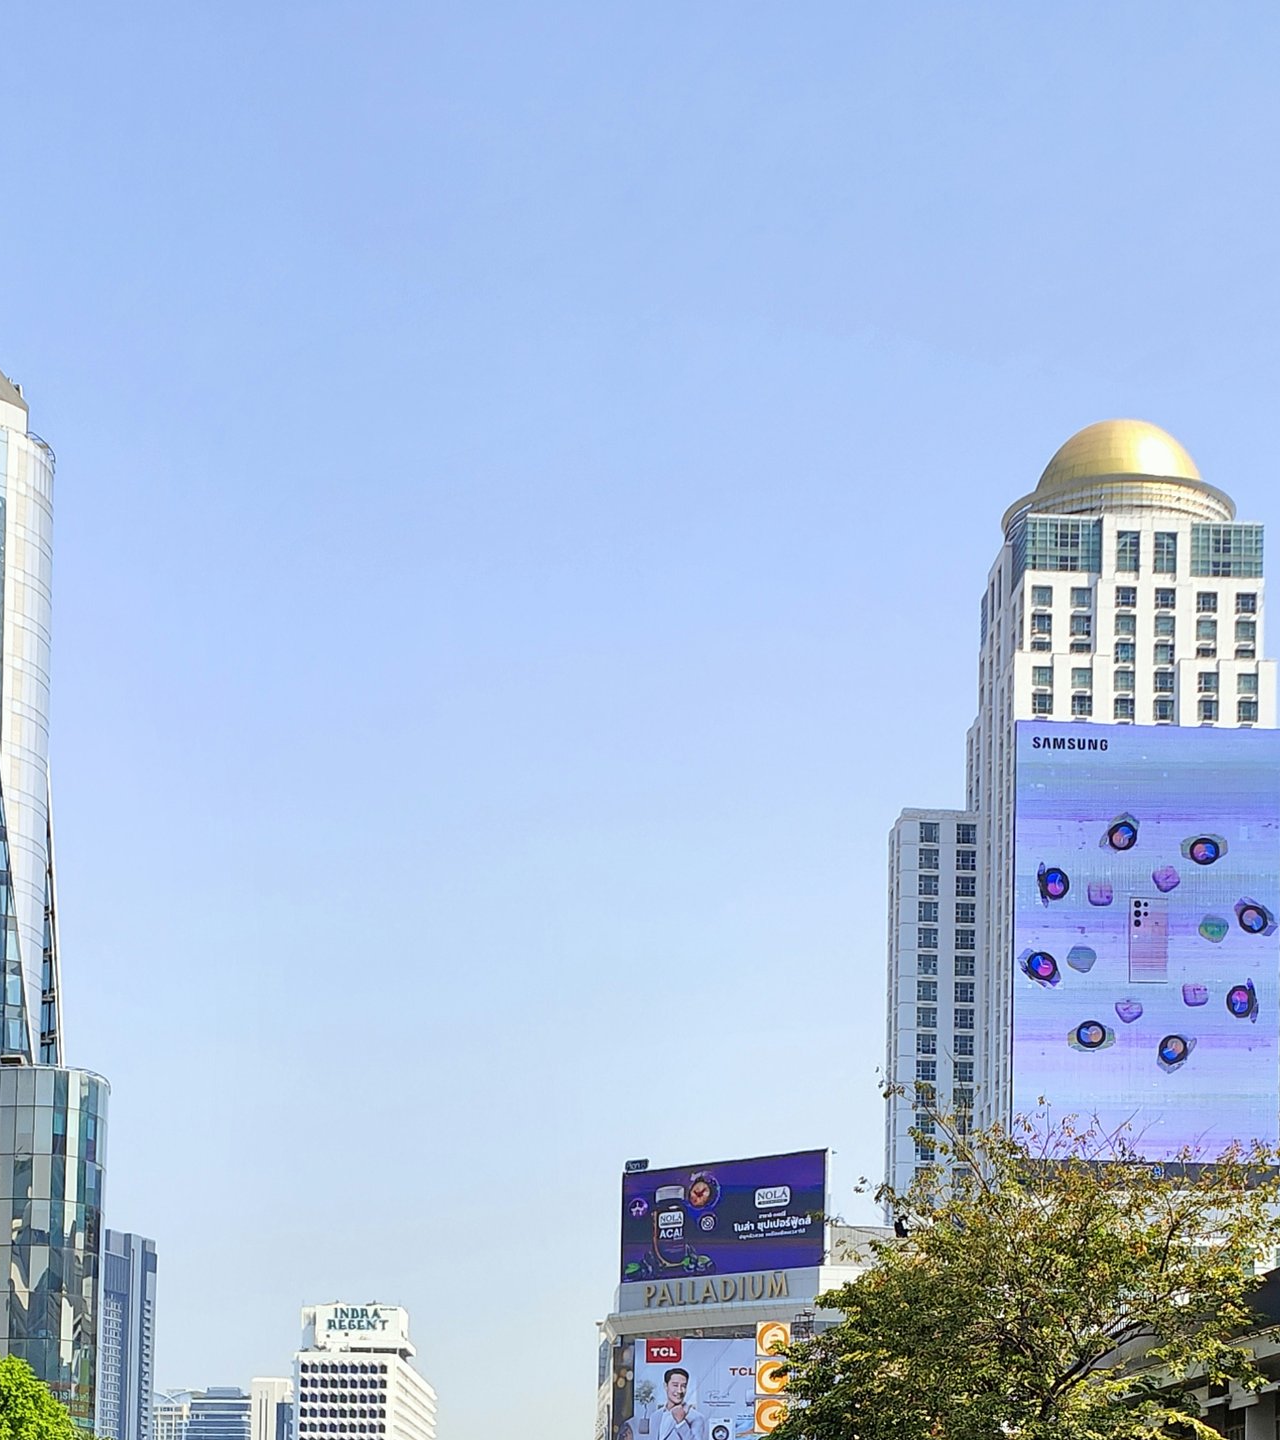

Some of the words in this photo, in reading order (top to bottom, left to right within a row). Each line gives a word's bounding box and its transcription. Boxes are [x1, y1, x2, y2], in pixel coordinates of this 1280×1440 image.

[1033, 737, 1108, 751] SAMSUNG
[659, 1228, 683, 1239] ACAI
[644, 1272, 789, 1308] PALLADIUM
[334, 1307, 381, 1319] INDRA
[327, 1319, 389, 1330] REGENT
[651, 1348, 677, 1357] TCL
[729, 1367, 756, 1377] TCL
